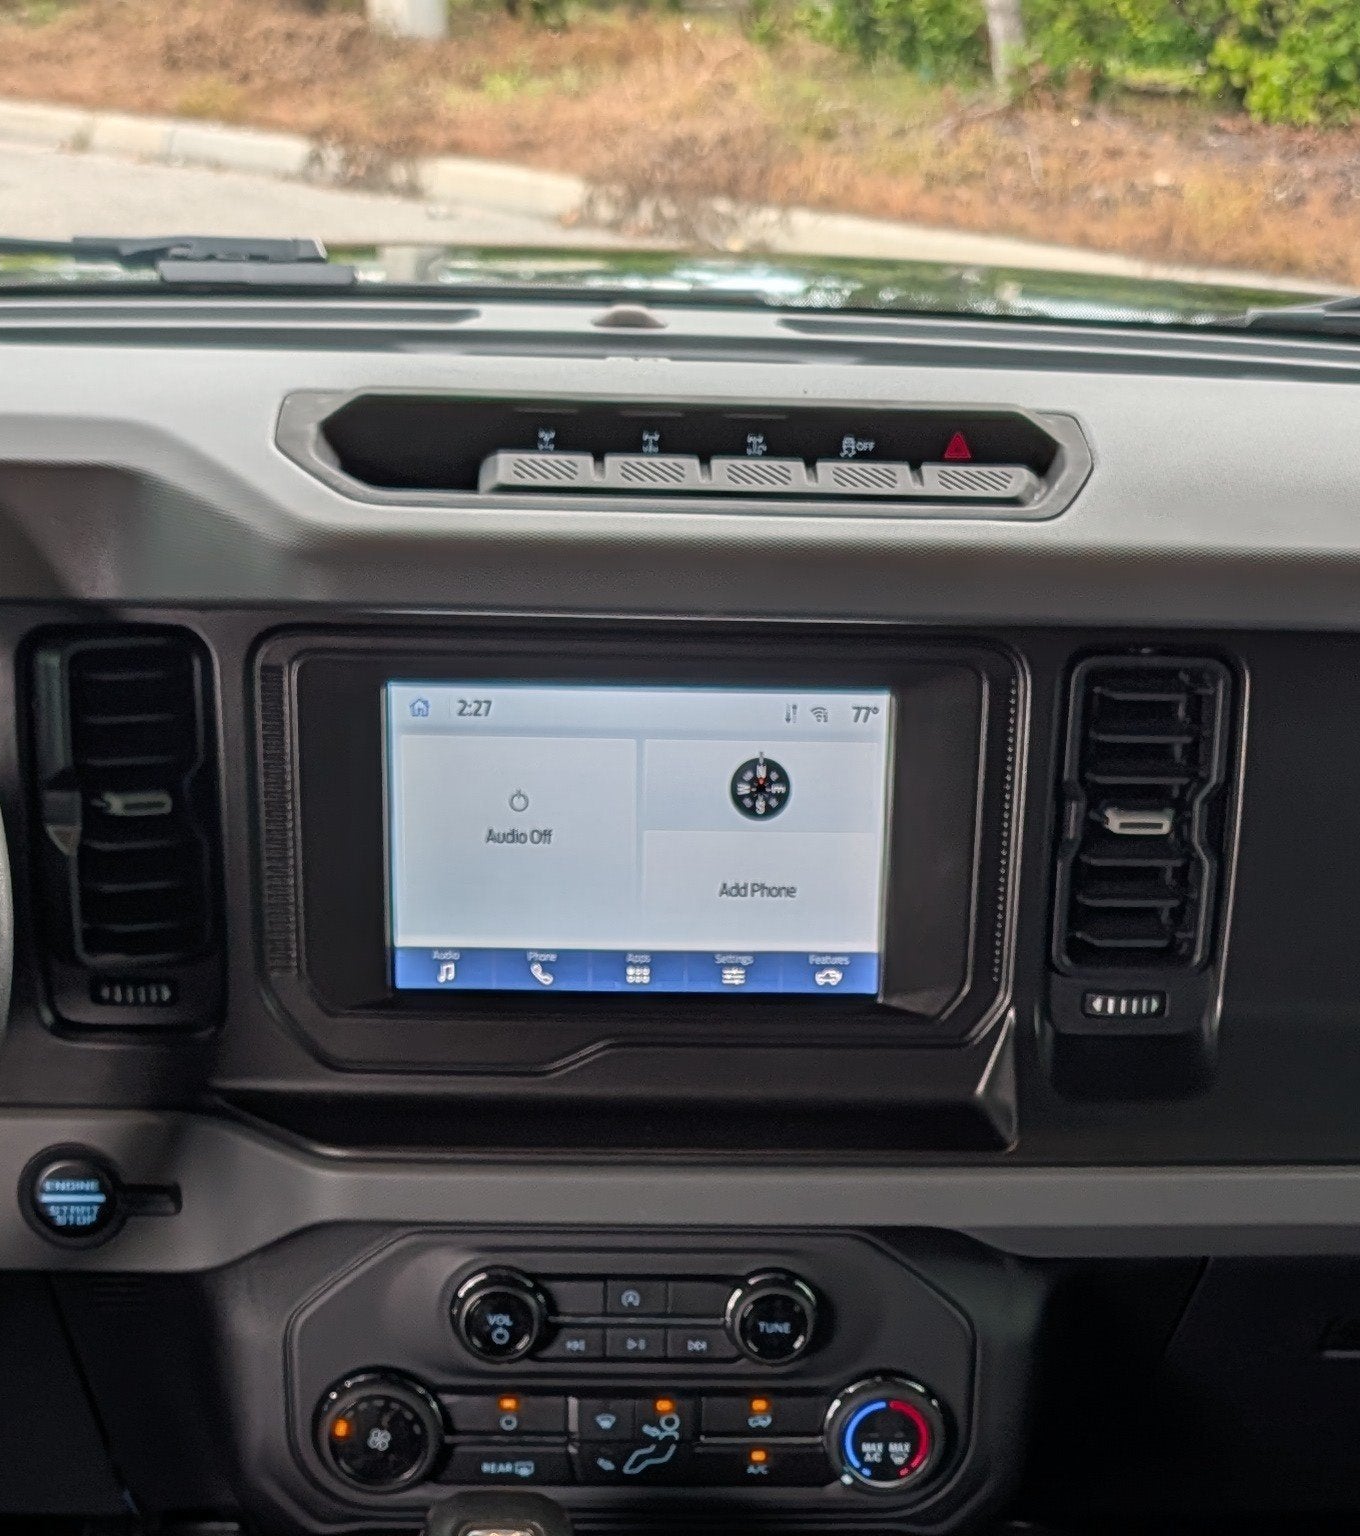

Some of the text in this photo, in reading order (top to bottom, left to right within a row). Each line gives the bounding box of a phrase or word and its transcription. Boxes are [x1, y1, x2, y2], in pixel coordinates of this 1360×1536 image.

[456, 700, 493, 718] 2:27
[485, 828, 554, 845] Audio Off
[718, 882, 798, 898] Add Phone
[432, 950, 461, 961] Audio
[526, 951, 559, 962] Phone
[625, 953, 652, 965] Apps
[713, 954, 754, 966] Settings
[808, 954, 851, 966] Features
[486, 1313, 514, 1327] VOL
[759, 1321, 791, 1334] TUNE
[861, 1441, 884, 1453] MAX
[888, 1441, 912, 1453] MAX
[481, 1461, 513, 1474] REAR
